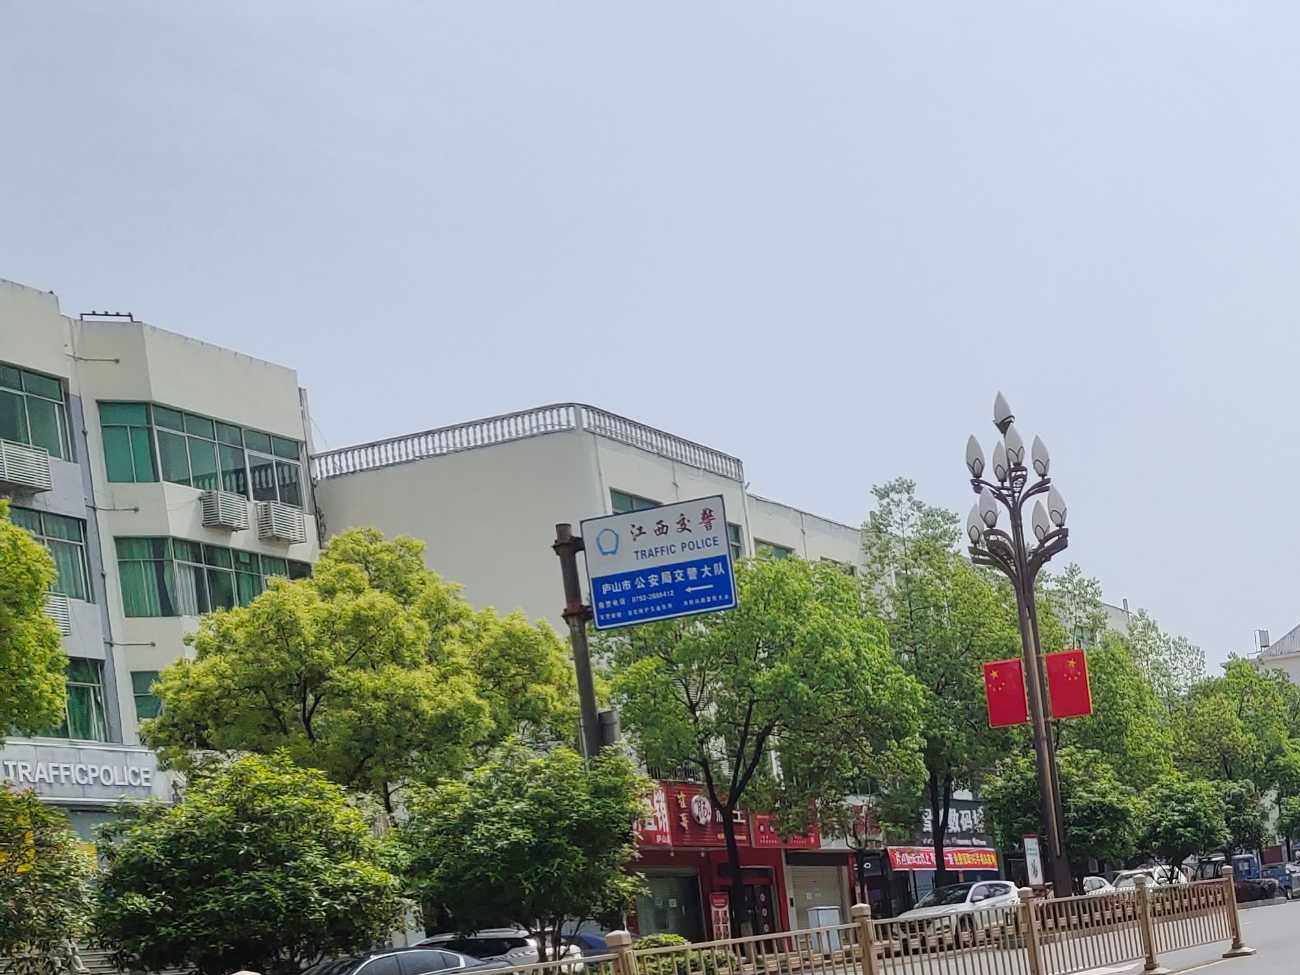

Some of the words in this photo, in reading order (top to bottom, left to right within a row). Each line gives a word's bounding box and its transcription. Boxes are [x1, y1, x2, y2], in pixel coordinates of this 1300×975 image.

[631, 508, 716, 541] 江西交警
[634, 544, 677, 561] TRAFFIC
[681, 536, 720, 553] POLICE
